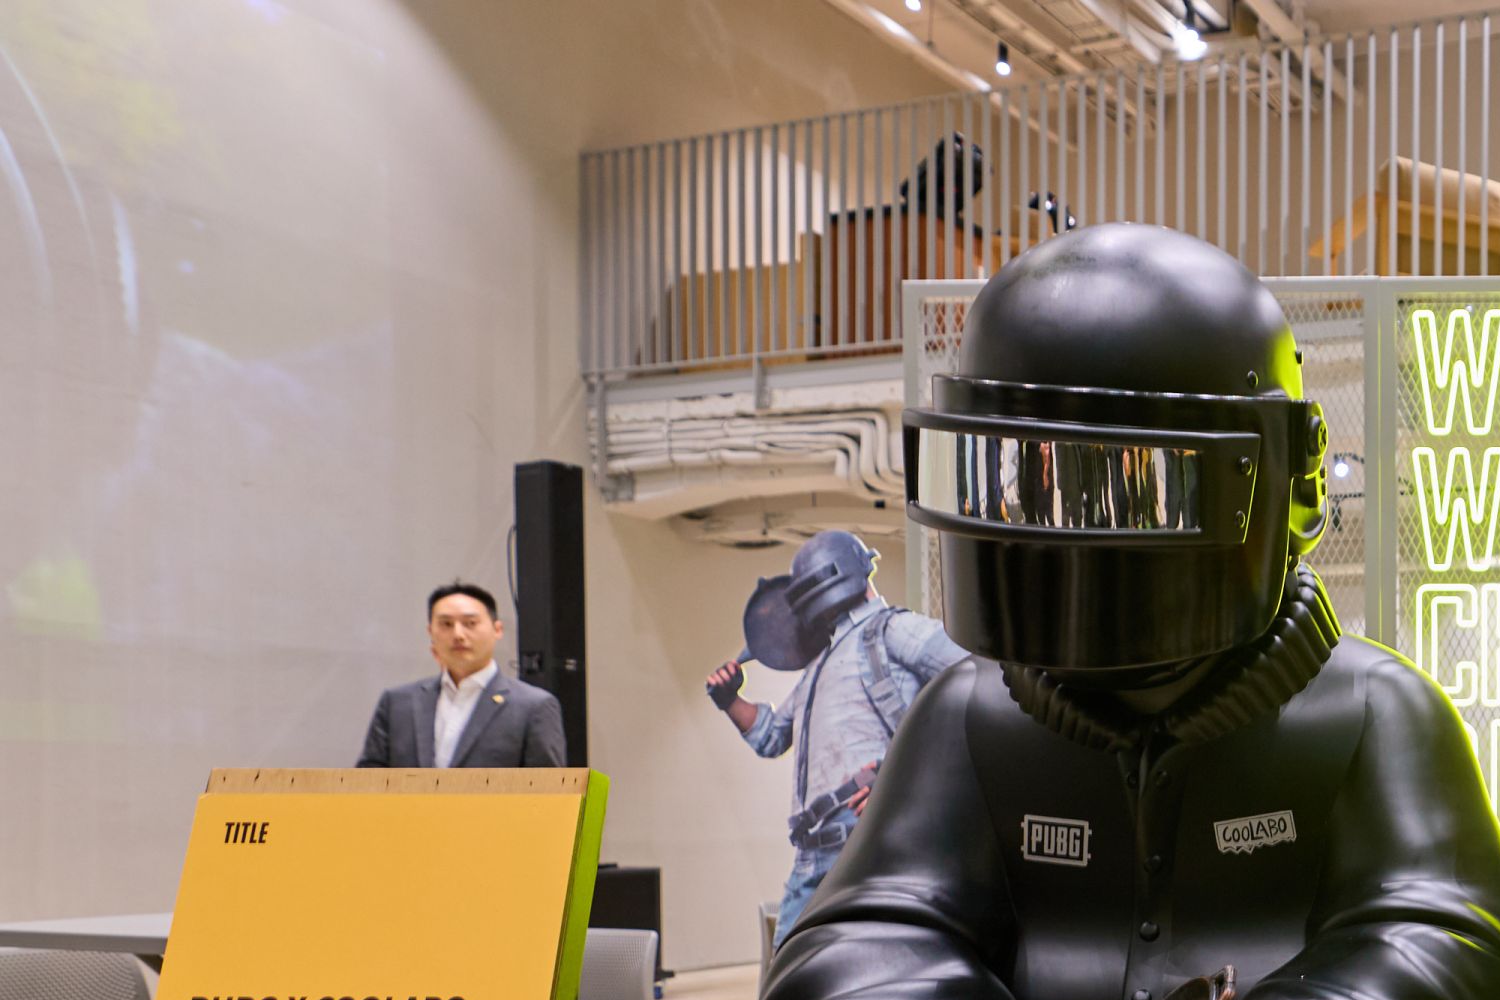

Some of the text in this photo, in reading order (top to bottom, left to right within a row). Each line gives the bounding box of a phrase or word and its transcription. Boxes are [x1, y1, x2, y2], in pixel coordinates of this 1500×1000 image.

[224, 821, 270, 844] TITLE
[1031, 823, 1081, 857] PUBG
[1221, 816, 1288, 844] COOLABO
